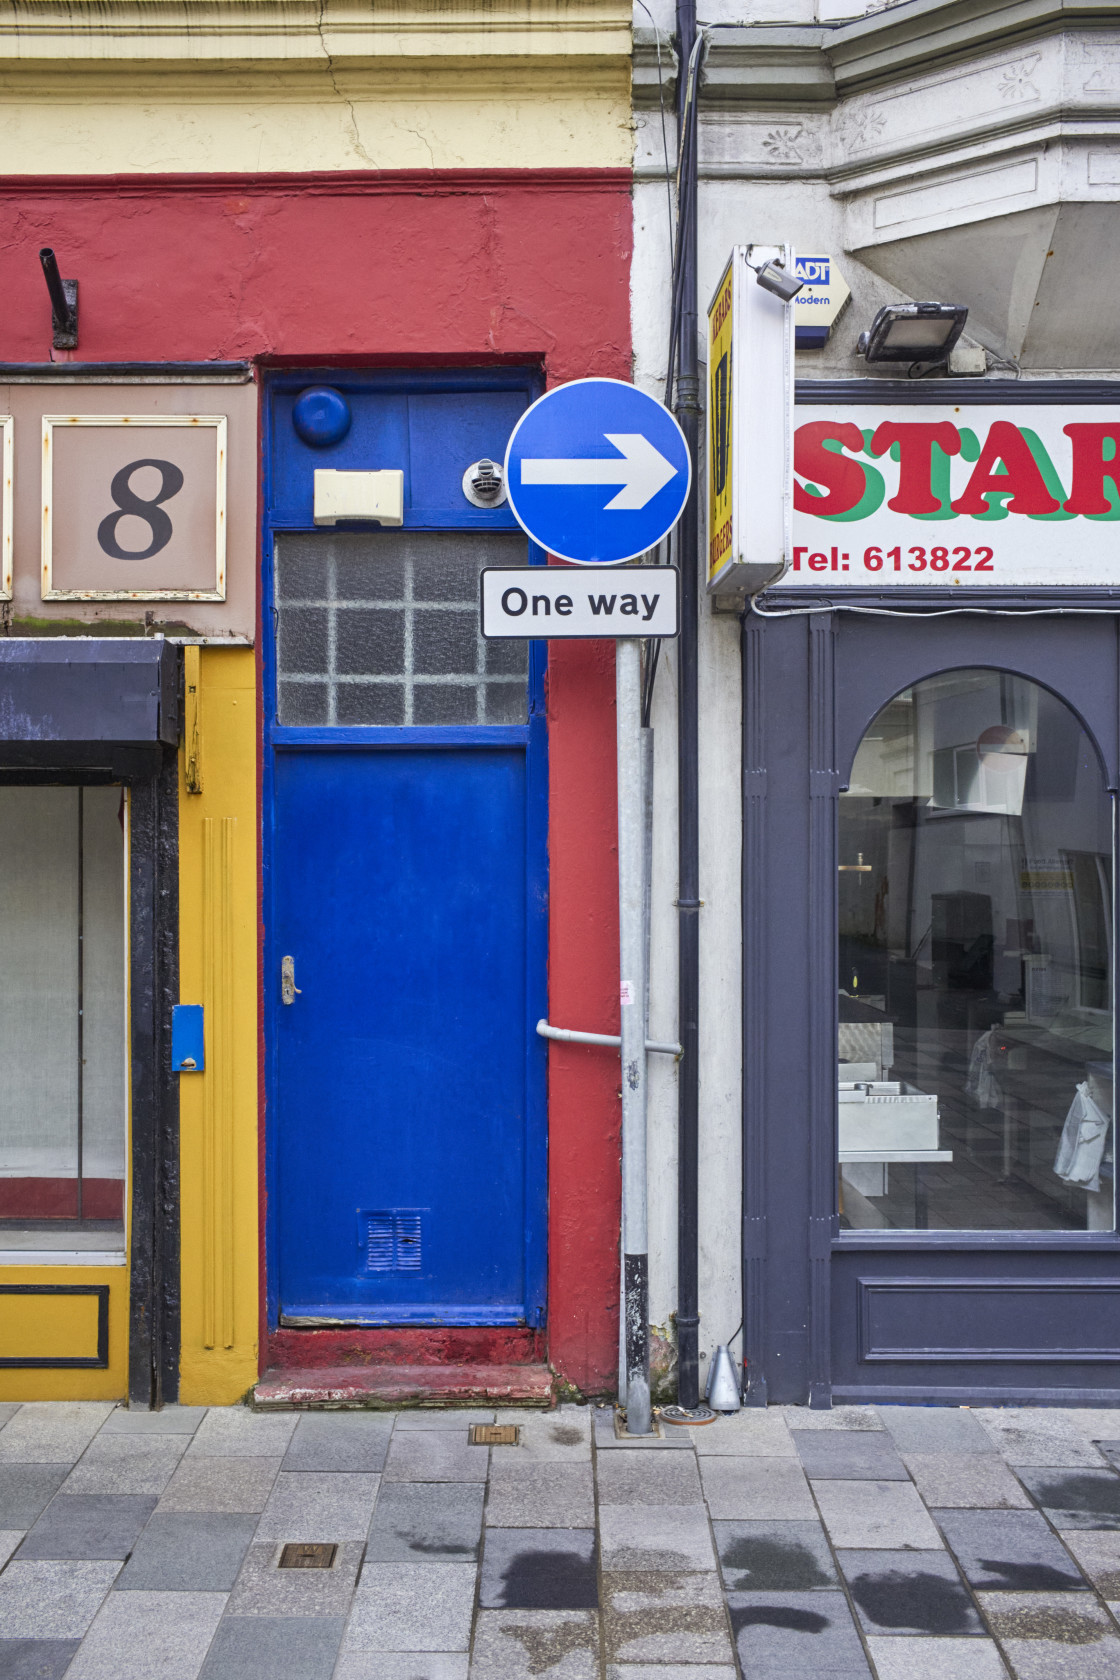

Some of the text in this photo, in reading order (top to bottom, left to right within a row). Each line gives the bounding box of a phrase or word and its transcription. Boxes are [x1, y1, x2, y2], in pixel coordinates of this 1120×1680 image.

[711, 279, 732, 345] KEBABS
[97, 458, 185, 561] 8
[710, 514, 733, 570] BURGERS
[793, 546, 995, 572] Tel: 613822
[501, 587, 660, 621] One way
